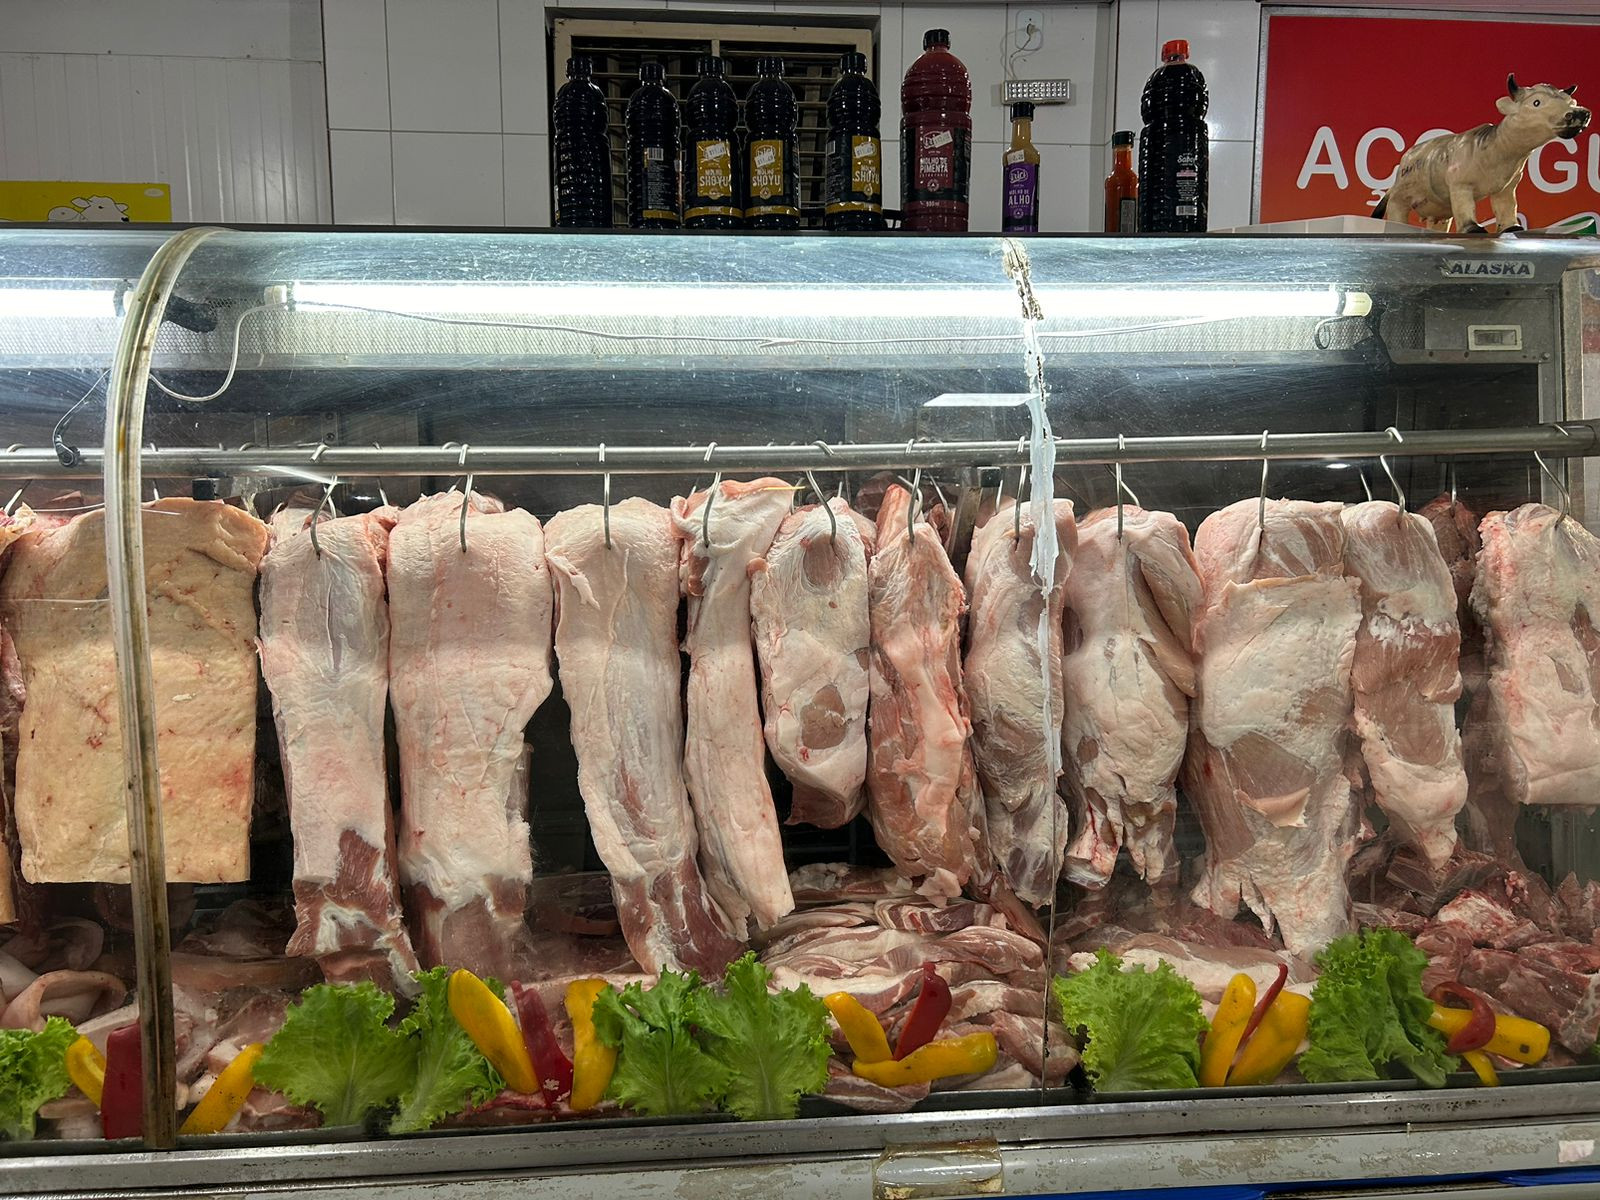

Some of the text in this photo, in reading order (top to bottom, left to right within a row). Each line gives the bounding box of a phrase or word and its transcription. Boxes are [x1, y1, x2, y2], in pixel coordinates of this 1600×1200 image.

[920, 164, 948, 173] PIMENTA
[700, 175, 729, 187] SHOYU
[752, 174, 781, 187] SHOYU
[854, 170, 880, 184] SHOYU
[1008, 194, 1030, 206] ALHO
[1450, 263, 1531, 276] ALASKA
